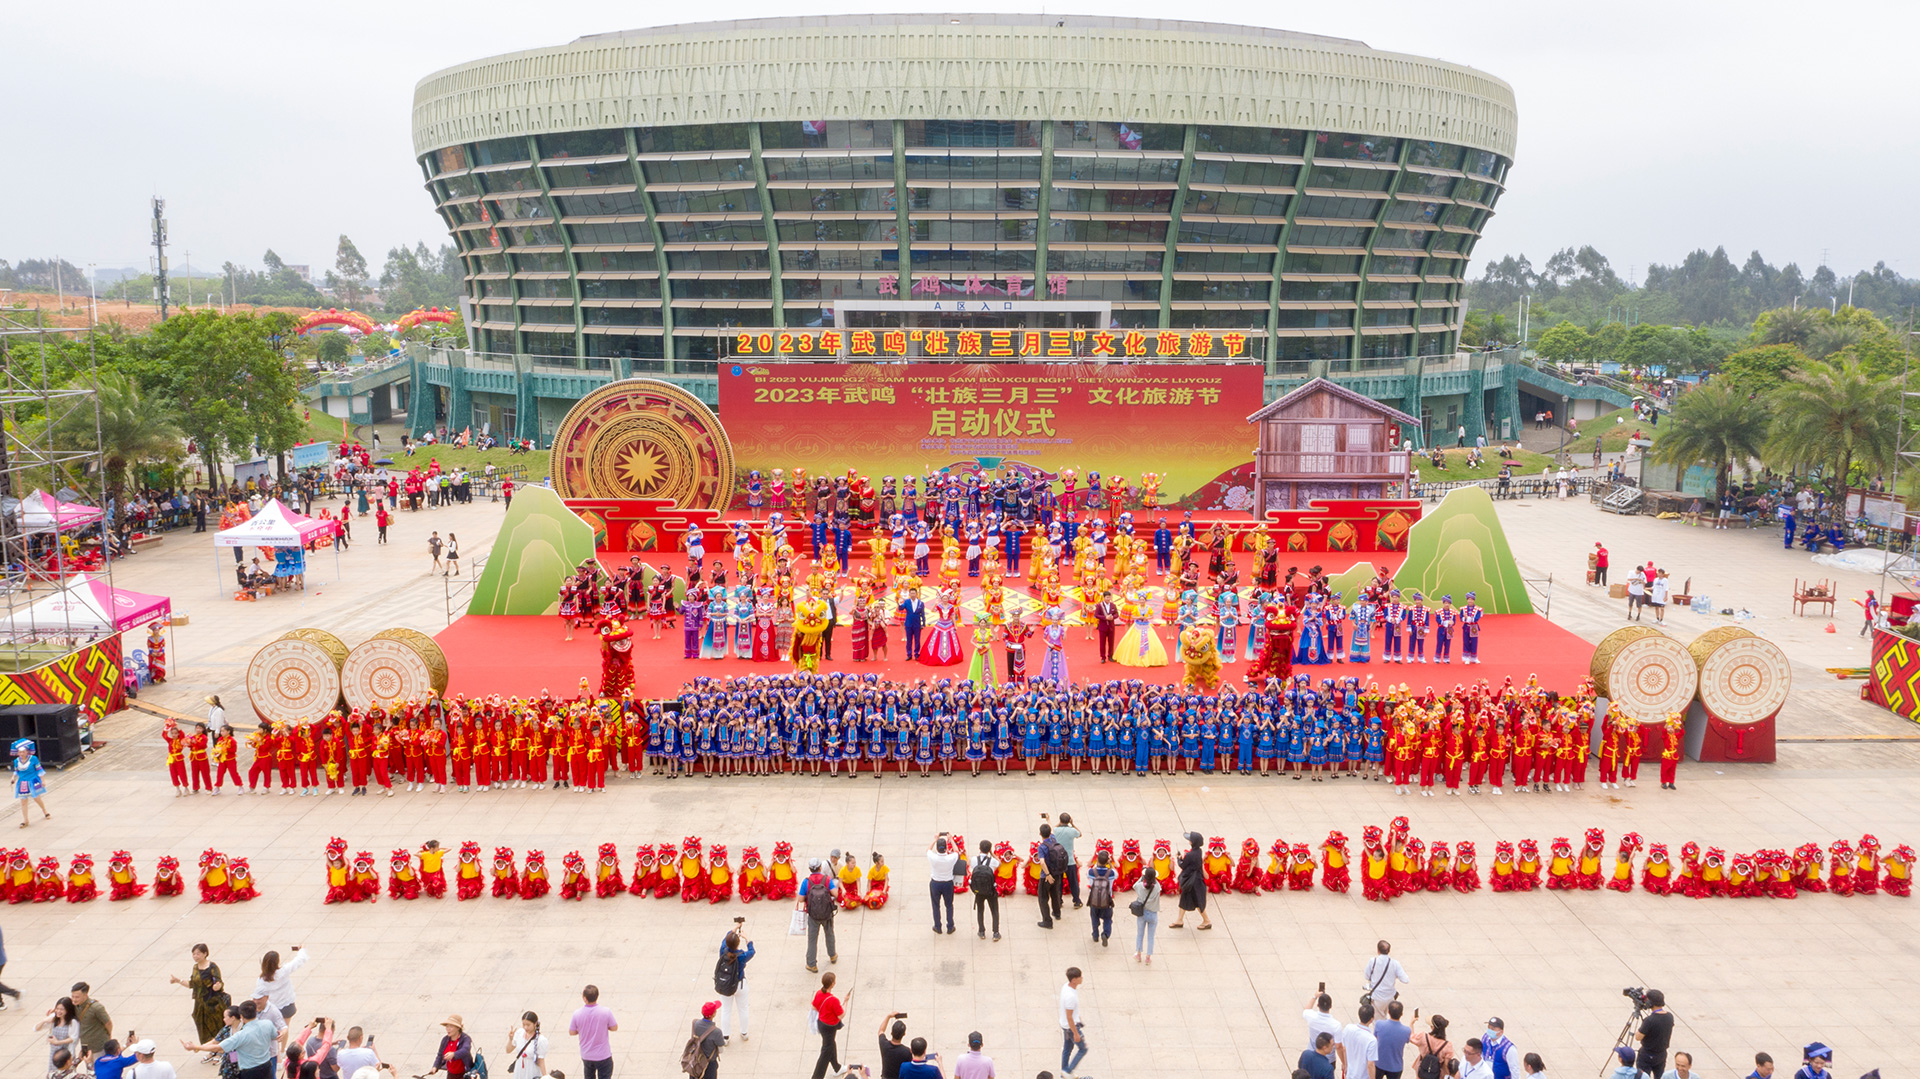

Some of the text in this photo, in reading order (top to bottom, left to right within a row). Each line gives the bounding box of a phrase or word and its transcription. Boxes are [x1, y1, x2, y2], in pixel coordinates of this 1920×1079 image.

[879, 274, 1069, 296] 武鸣体育馆
[928, 407, 1057, 437] 启动仪式
